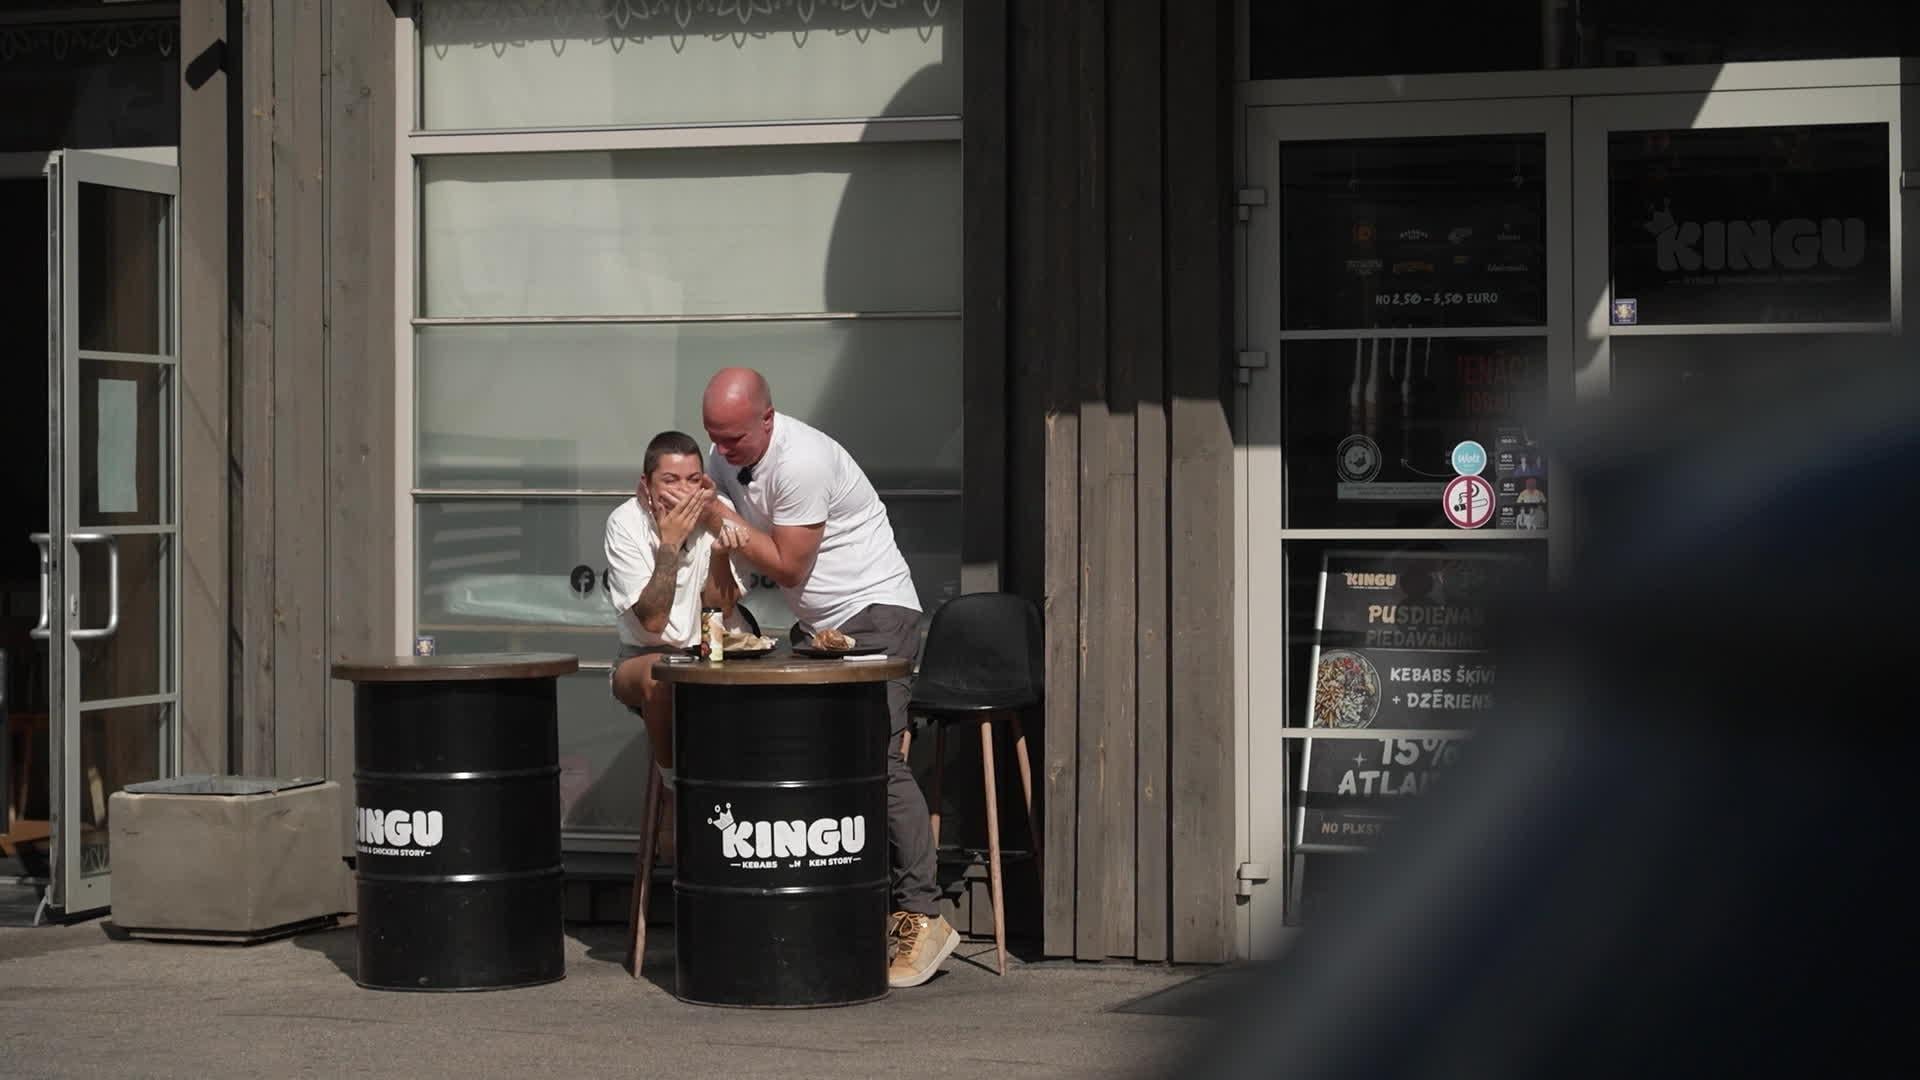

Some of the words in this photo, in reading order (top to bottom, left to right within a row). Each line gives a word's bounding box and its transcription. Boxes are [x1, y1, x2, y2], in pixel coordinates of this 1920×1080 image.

[1656, 217, 1866, 271] KINGU
[1375, 294, 1391, 305] NO
[1467, 292, 1498, 304] EURO
[1458, 451, 1481, 464] Wolt
[1345, 572, 1397, 587] KINGU
[1390, 667, 1451, 682] KEBABS
[1378, 738, 1457, 766] 15%
[1321, 823, 1339, 834] NO
[722, 815, 866, 858] KINGU
[400, 849, 426, 857] STORY
[742, 861, 778, 869] KEBABS
[828, 857, 853, 866] STORY
